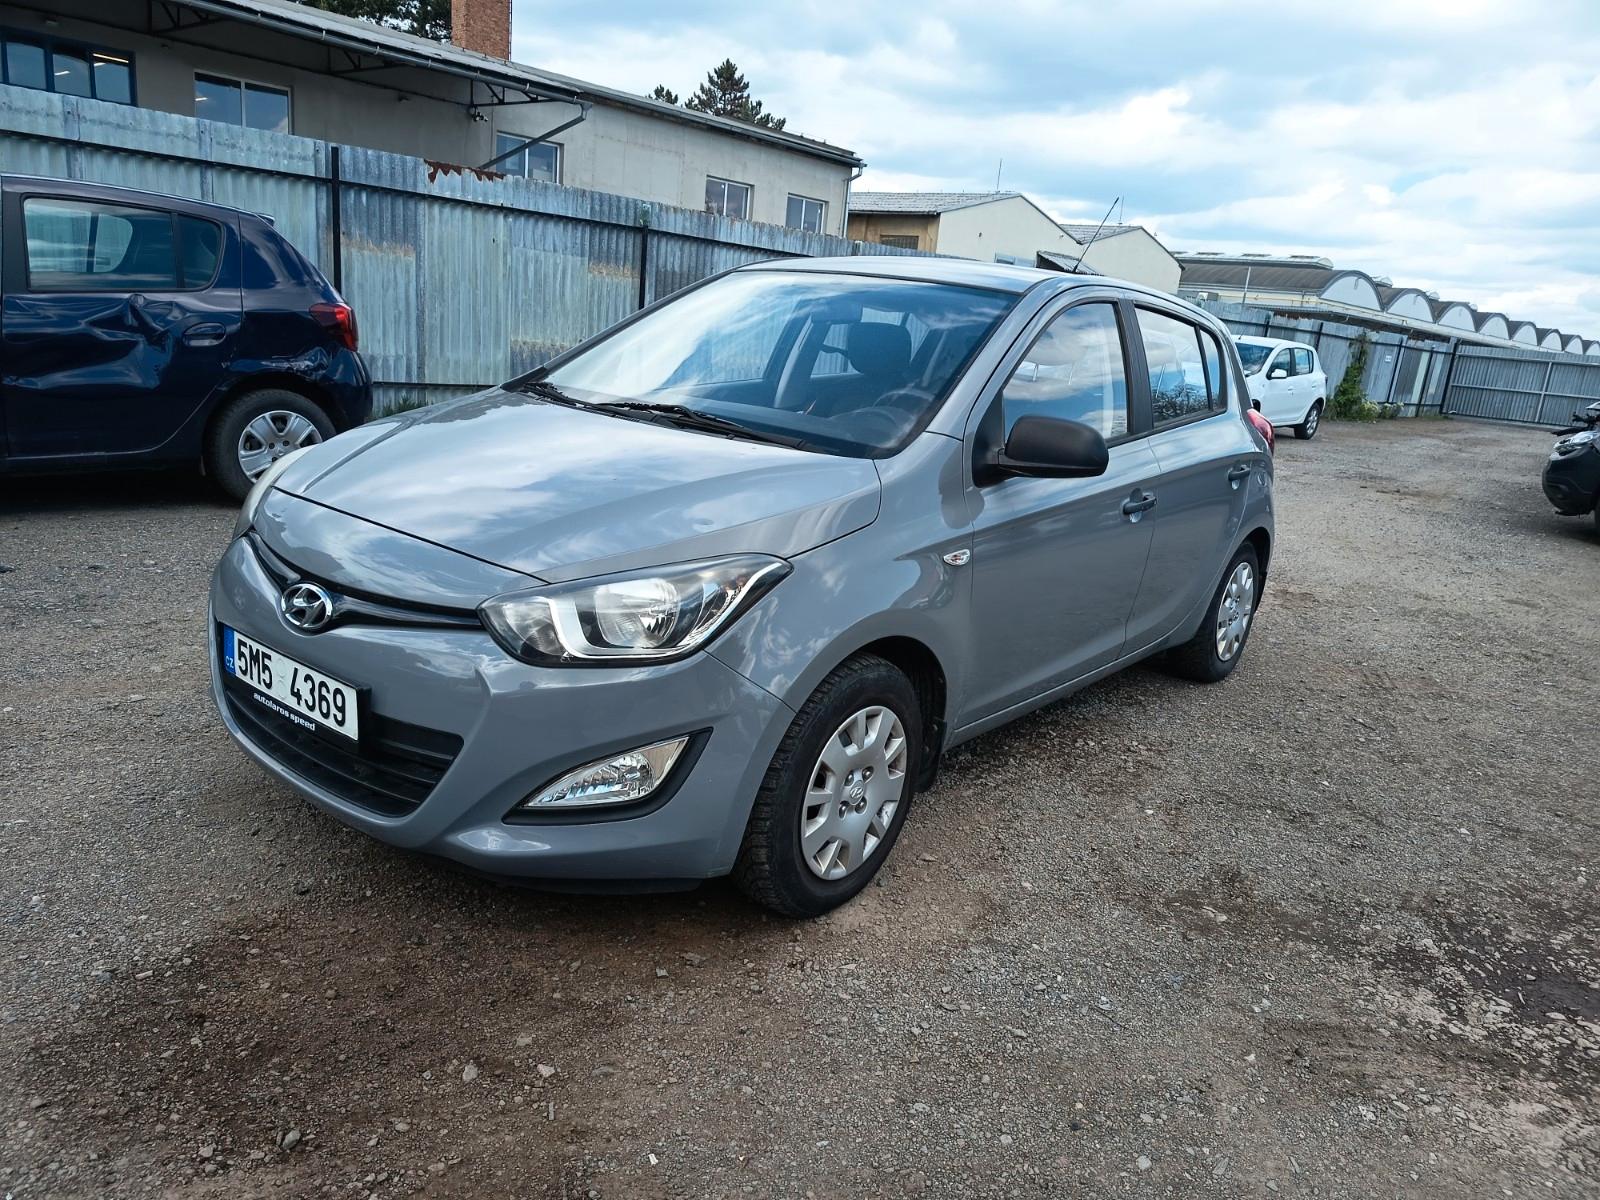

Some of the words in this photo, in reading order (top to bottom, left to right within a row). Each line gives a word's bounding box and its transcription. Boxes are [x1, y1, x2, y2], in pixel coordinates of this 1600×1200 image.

[225, 655, 235, 669] CZ
[237, 638, 273, 690] 5M5
[290, 666, 346, 727] 4369
[290, 713, 316, 731] speed
